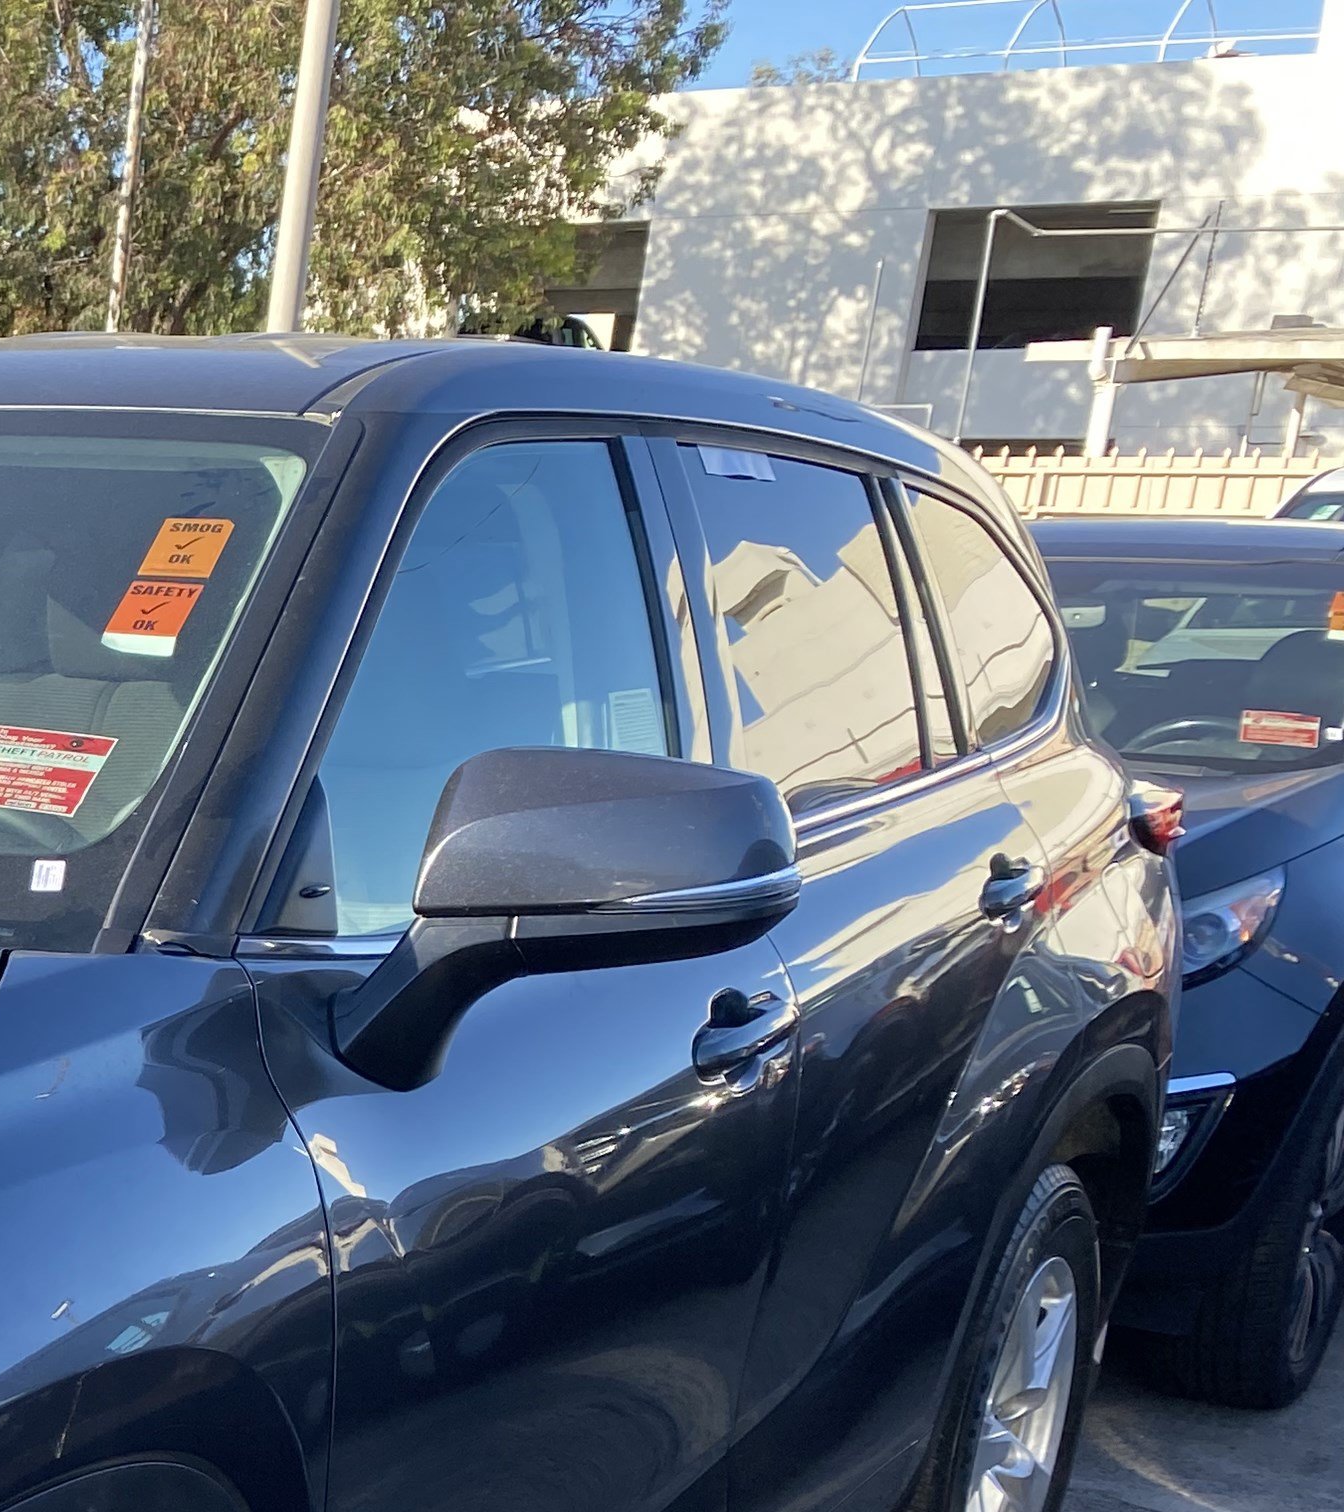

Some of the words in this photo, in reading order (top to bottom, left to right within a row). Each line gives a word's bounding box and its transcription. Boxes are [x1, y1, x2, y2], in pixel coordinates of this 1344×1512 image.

[169, 522, 224, 533] SMOG
[168, 553, 194, 564] OK
[130, 585, 198, 599] SAFETY
[132, 619, 158, 631] OK
